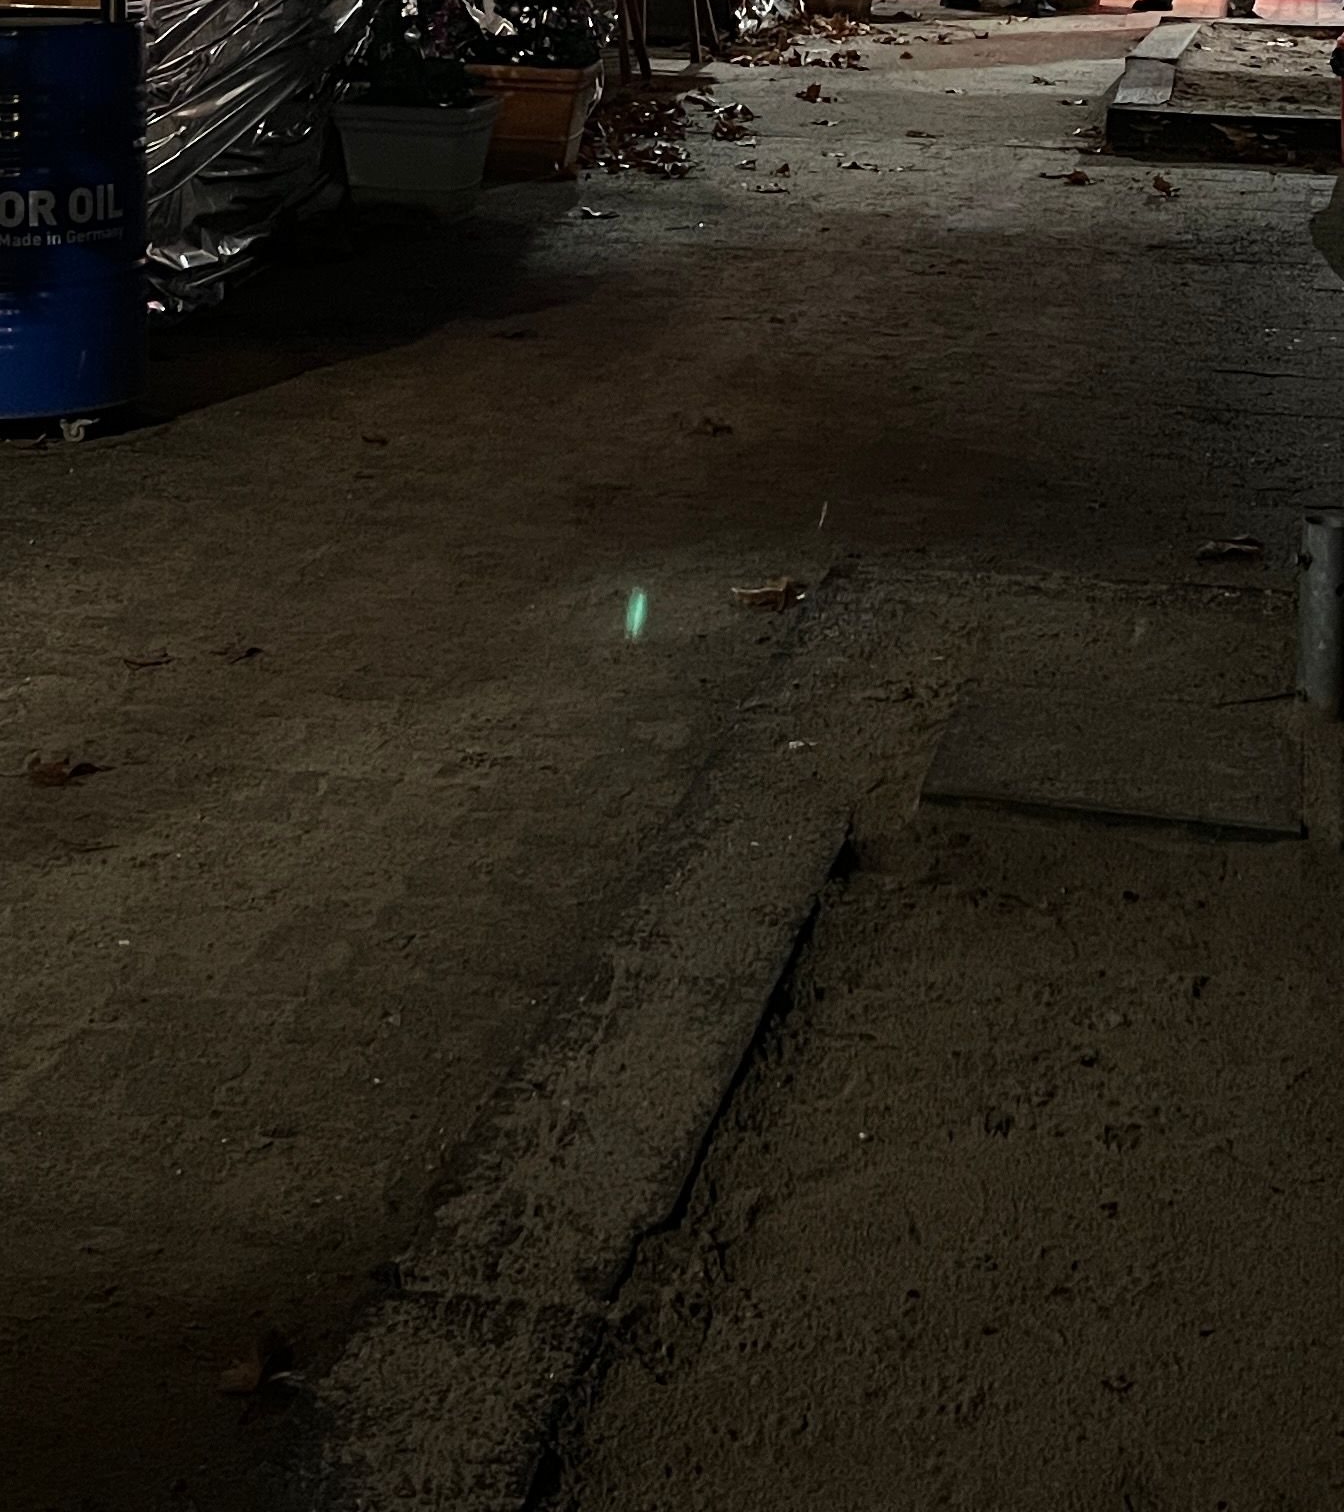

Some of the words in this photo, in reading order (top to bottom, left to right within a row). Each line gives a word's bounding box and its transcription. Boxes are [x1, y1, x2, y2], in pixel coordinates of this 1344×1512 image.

[67, 183, 124, 224] OIL
[46, 231, 62, 246] in
[66, 225, 125, 244] Germany
